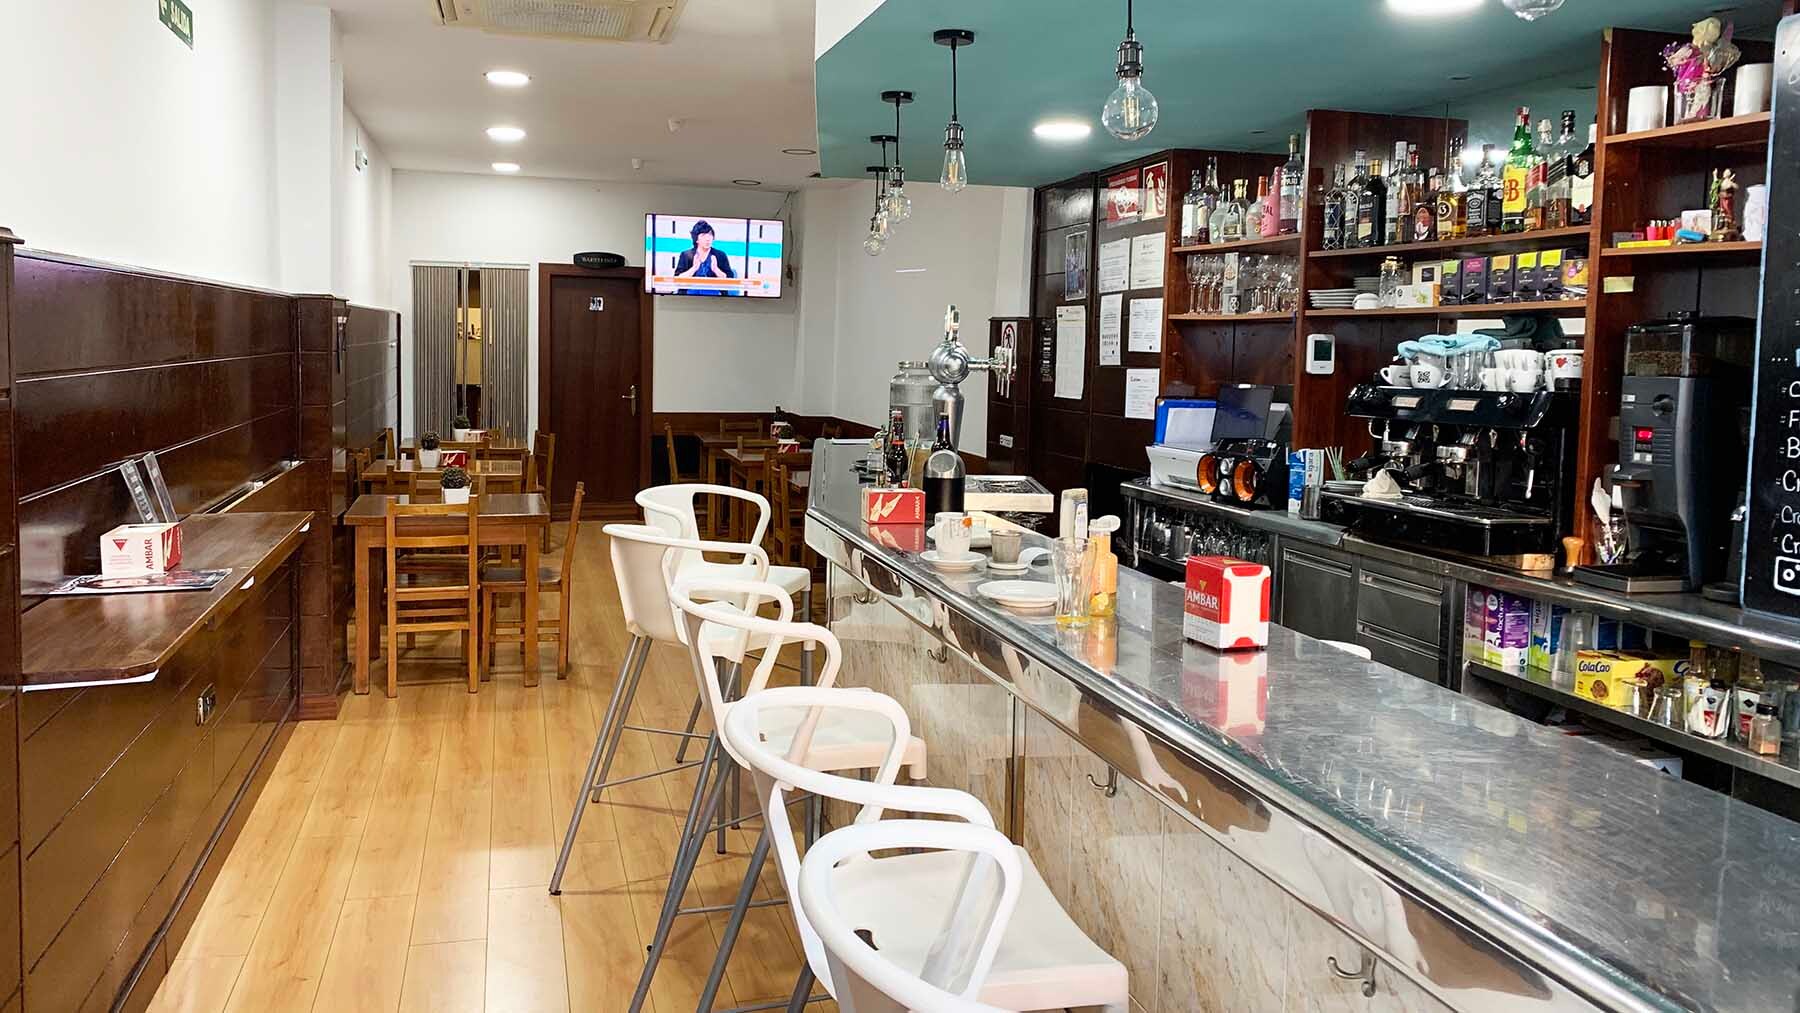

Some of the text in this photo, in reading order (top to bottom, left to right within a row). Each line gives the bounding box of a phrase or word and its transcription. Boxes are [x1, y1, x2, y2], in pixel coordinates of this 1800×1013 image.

[171, 0, 191, 38] SALIDA
[144, 537, 154, 570] AMBAR
[1186, 590, 1218, 609] AMBAR
